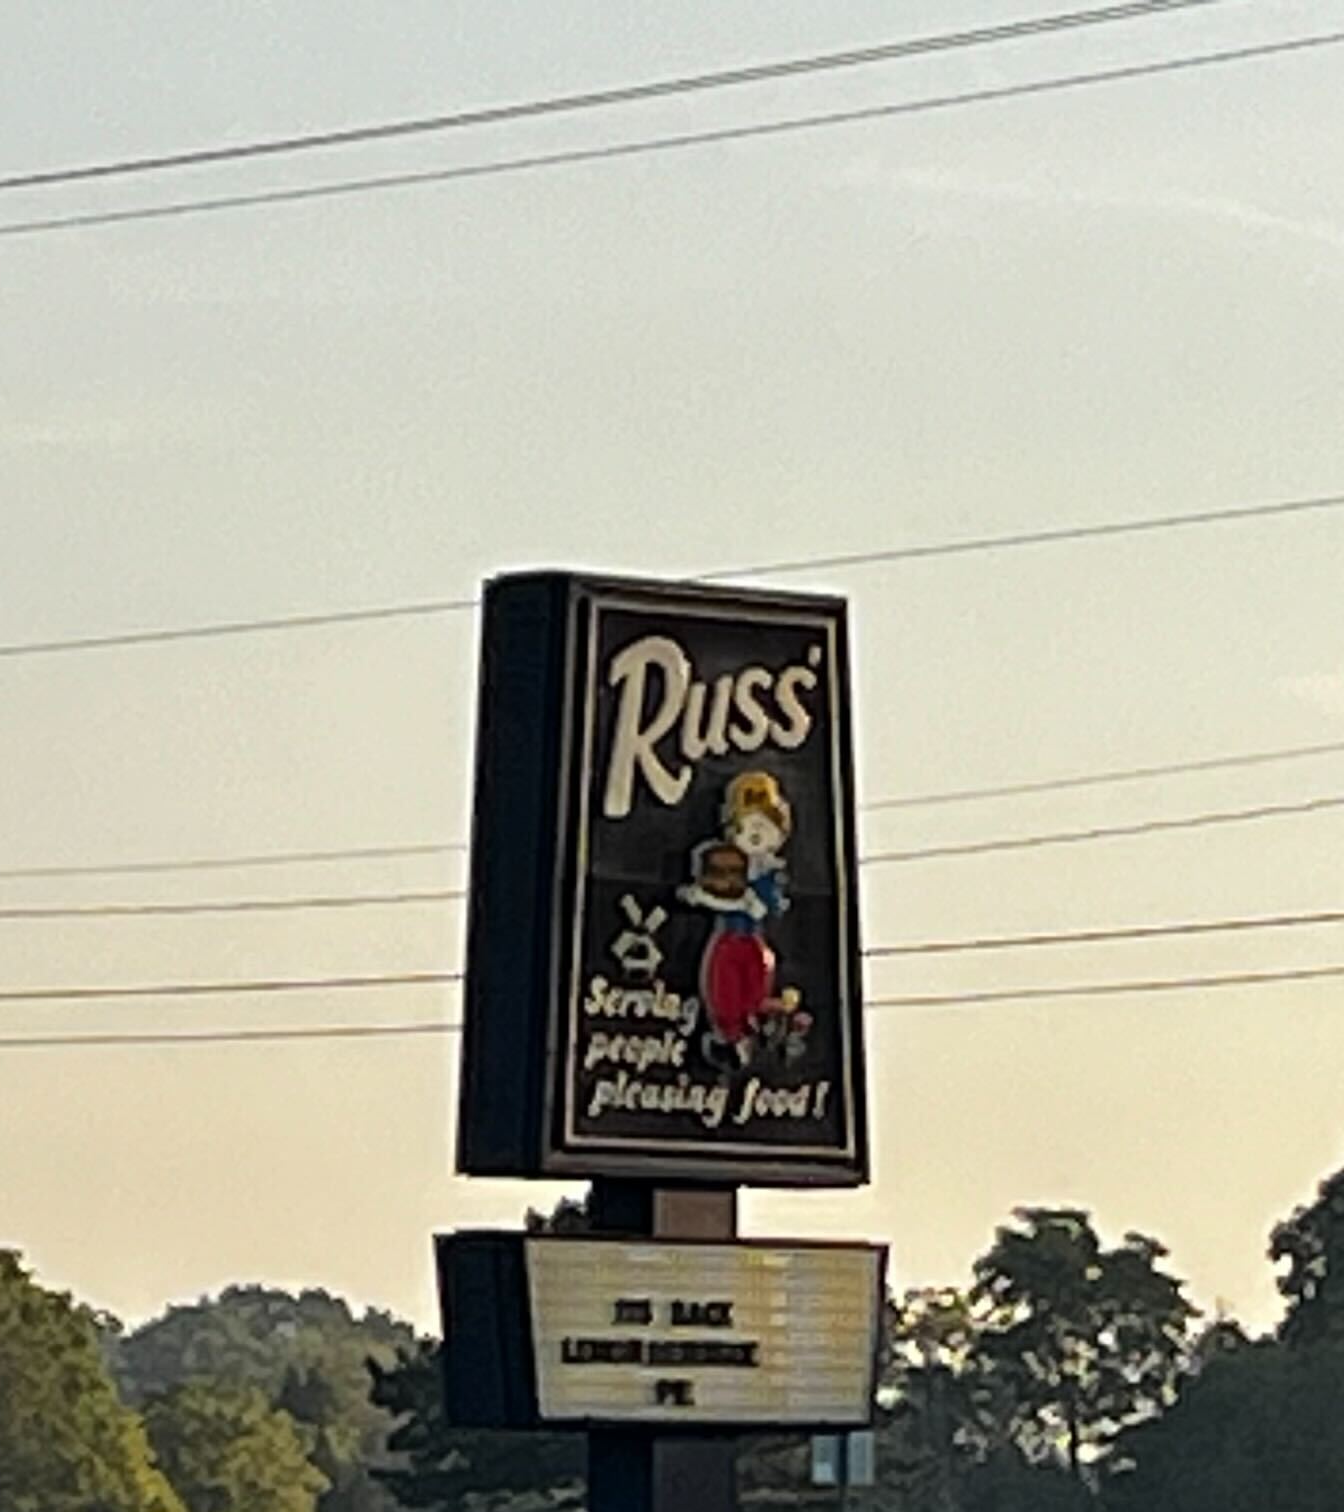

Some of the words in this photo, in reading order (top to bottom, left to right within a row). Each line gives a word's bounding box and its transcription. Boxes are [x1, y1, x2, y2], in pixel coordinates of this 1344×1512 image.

[583, 974, 700, 1037] Serving
[583, 1030, 689, 1072] people
[586, 1069, 730, 1128] pleasing
[730, 1076, 832, 1125] food!
